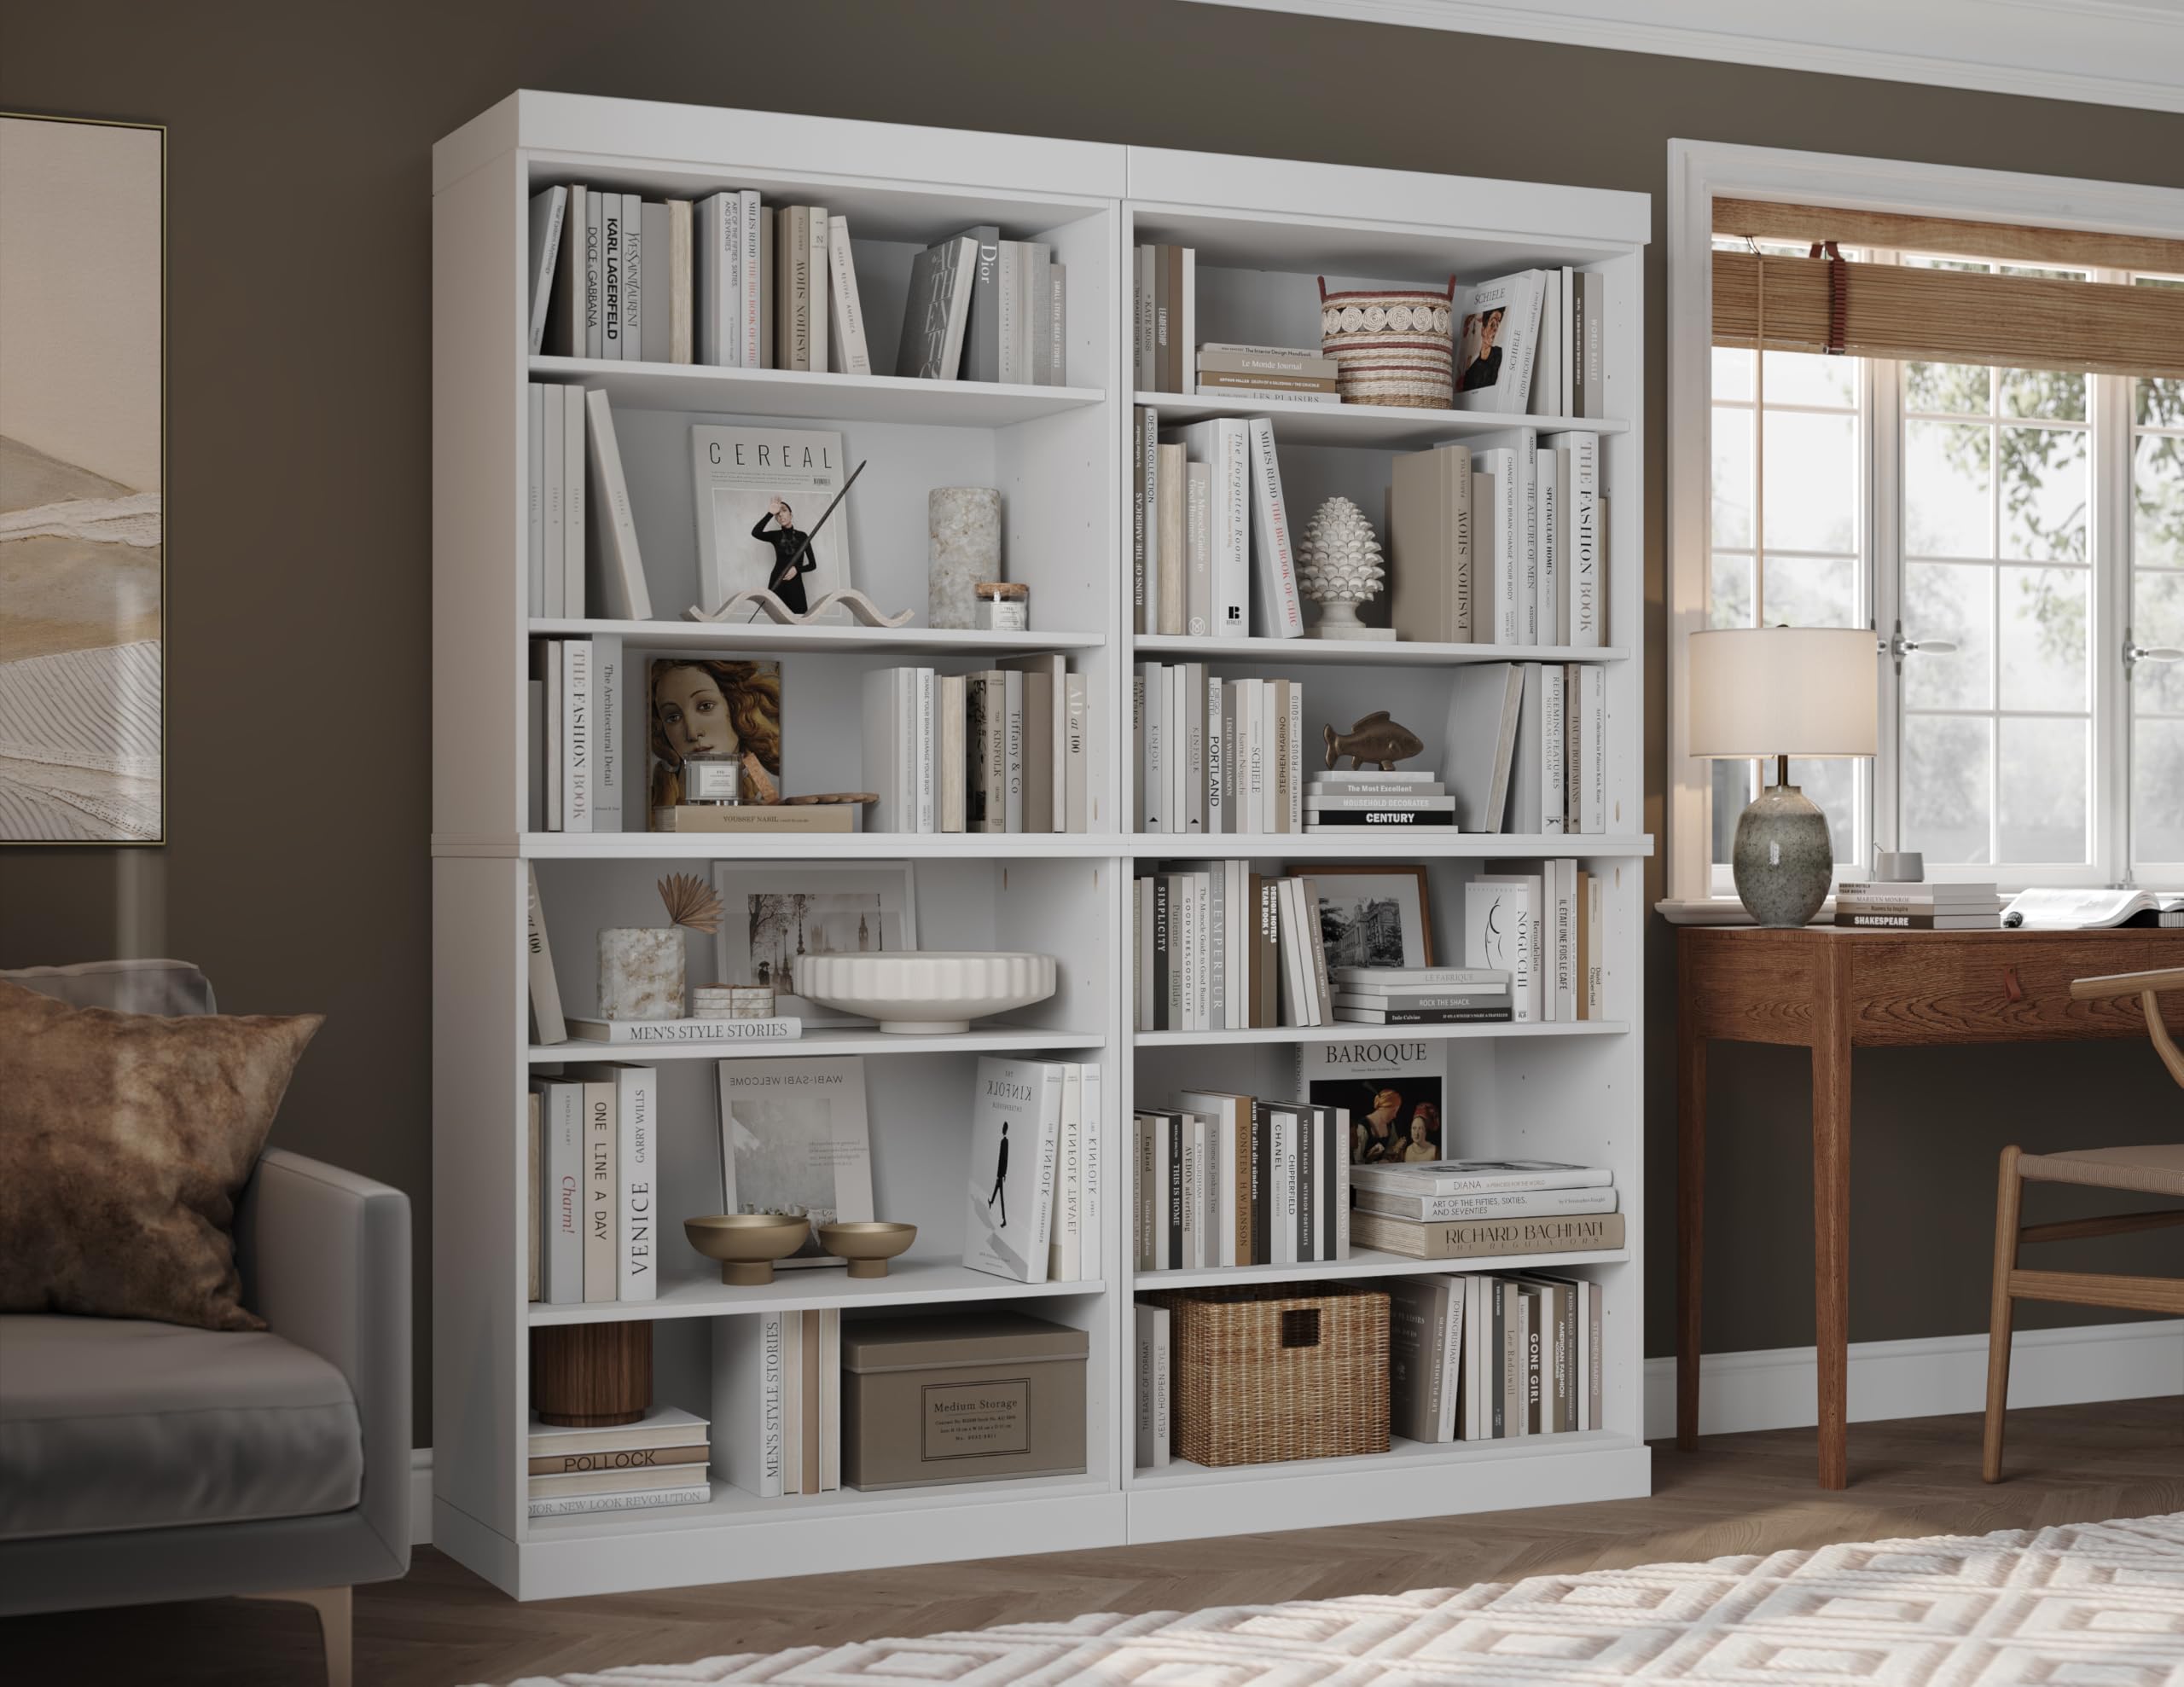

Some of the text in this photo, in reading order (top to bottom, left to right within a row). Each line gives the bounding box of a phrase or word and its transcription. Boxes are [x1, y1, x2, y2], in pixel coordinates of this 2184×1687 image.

[588, 227, 597, 328] DOLCE GABBANA
[607, 218, 618, 340] KARL LAGERFELD
[981, 244, 996, 284] Dior
[796, 259, 806, 362] FASHION SHOW
[1474, 287, 1506, 306] SCHIELE
[1159, 307, 1167, 345] LEADERSHIP
[1509, 330, 1522, 371] SCHIELE
[709, 442, 832, 469] CEREAL
[1233, 433, 1243, 563] The Forgotten Room
[1259, 430, 1298, 628] MILES REDD THE BIG BOOK OF CHIC
[1580, 442, 1592, 632] THE FASHION BOOK
[1136, 563, 1142, 576] OF
[1458, 510, 1468, 629] FASHION SHOW
[1527, 548, 1535, 563] OF
[573, 649, 585, 819] THE FASHION BOOK
[604, 664, 613, 786] The Architectural Detail
[1069, 686, 1083, 753] AD at 100
[993, 729, 1002, 776] KINFOLK
[1008, 710, 1020, 794] Tiffany & Co
[1211, 736, 1220, 807] PORTLAND
[1252, 747, 1260, 793] SCHIELE
[1365, 813, 1415, 823] CENTURY
[1854, 916, 1909, 926] SHAKESPEARE
[1213, 898, 1223, 1011] LEMPEREUR
[1517, 910, 1527, 988] NOGUCHI
[1170, 971, 1180, 1008] Holiday
[1420, 998, 1436, 1006] ROCK
[1450, 997, 1470, 1006] SHACK
[630, 1023, 787, 1041] MEN'S STYLE STORIES
[1325, 1043, 1427, 1065] BAROQUE
[595, 1102, 607, 1240] ONE LINE A DAY
[631, 1090, 648, 1277] VENICE GARRY WILLS
[1173, 1187, 1180, 1196] IS
[1454, 1180, 1482, 1191] DIANA
[561, 1175, 576, 1234] Charm!
[1183, 1186, 1192, 1232] advertising
[1432, 1199, 1446, 1209] ART
[1447, 1199, 1458, 1208] OF
[1460, 1198, 1474, 1208] THE
[1475, 1197, 1501, 1207] FIFTIES,
[1432, 1205, 1487, 1216] AND SEVENTIES
[1446, 1220, 1604, 1244] RICHARD BACHMAN
[767, 1321, 778, 1478] MEN'S STYLE STORIES
[934, 1398, 1018, 1412] Medium Storage
[564, 1451, 656, 1472] POLLOCK
[560, 1492, 701, 1513] NEW LOOK REVOLUTION
